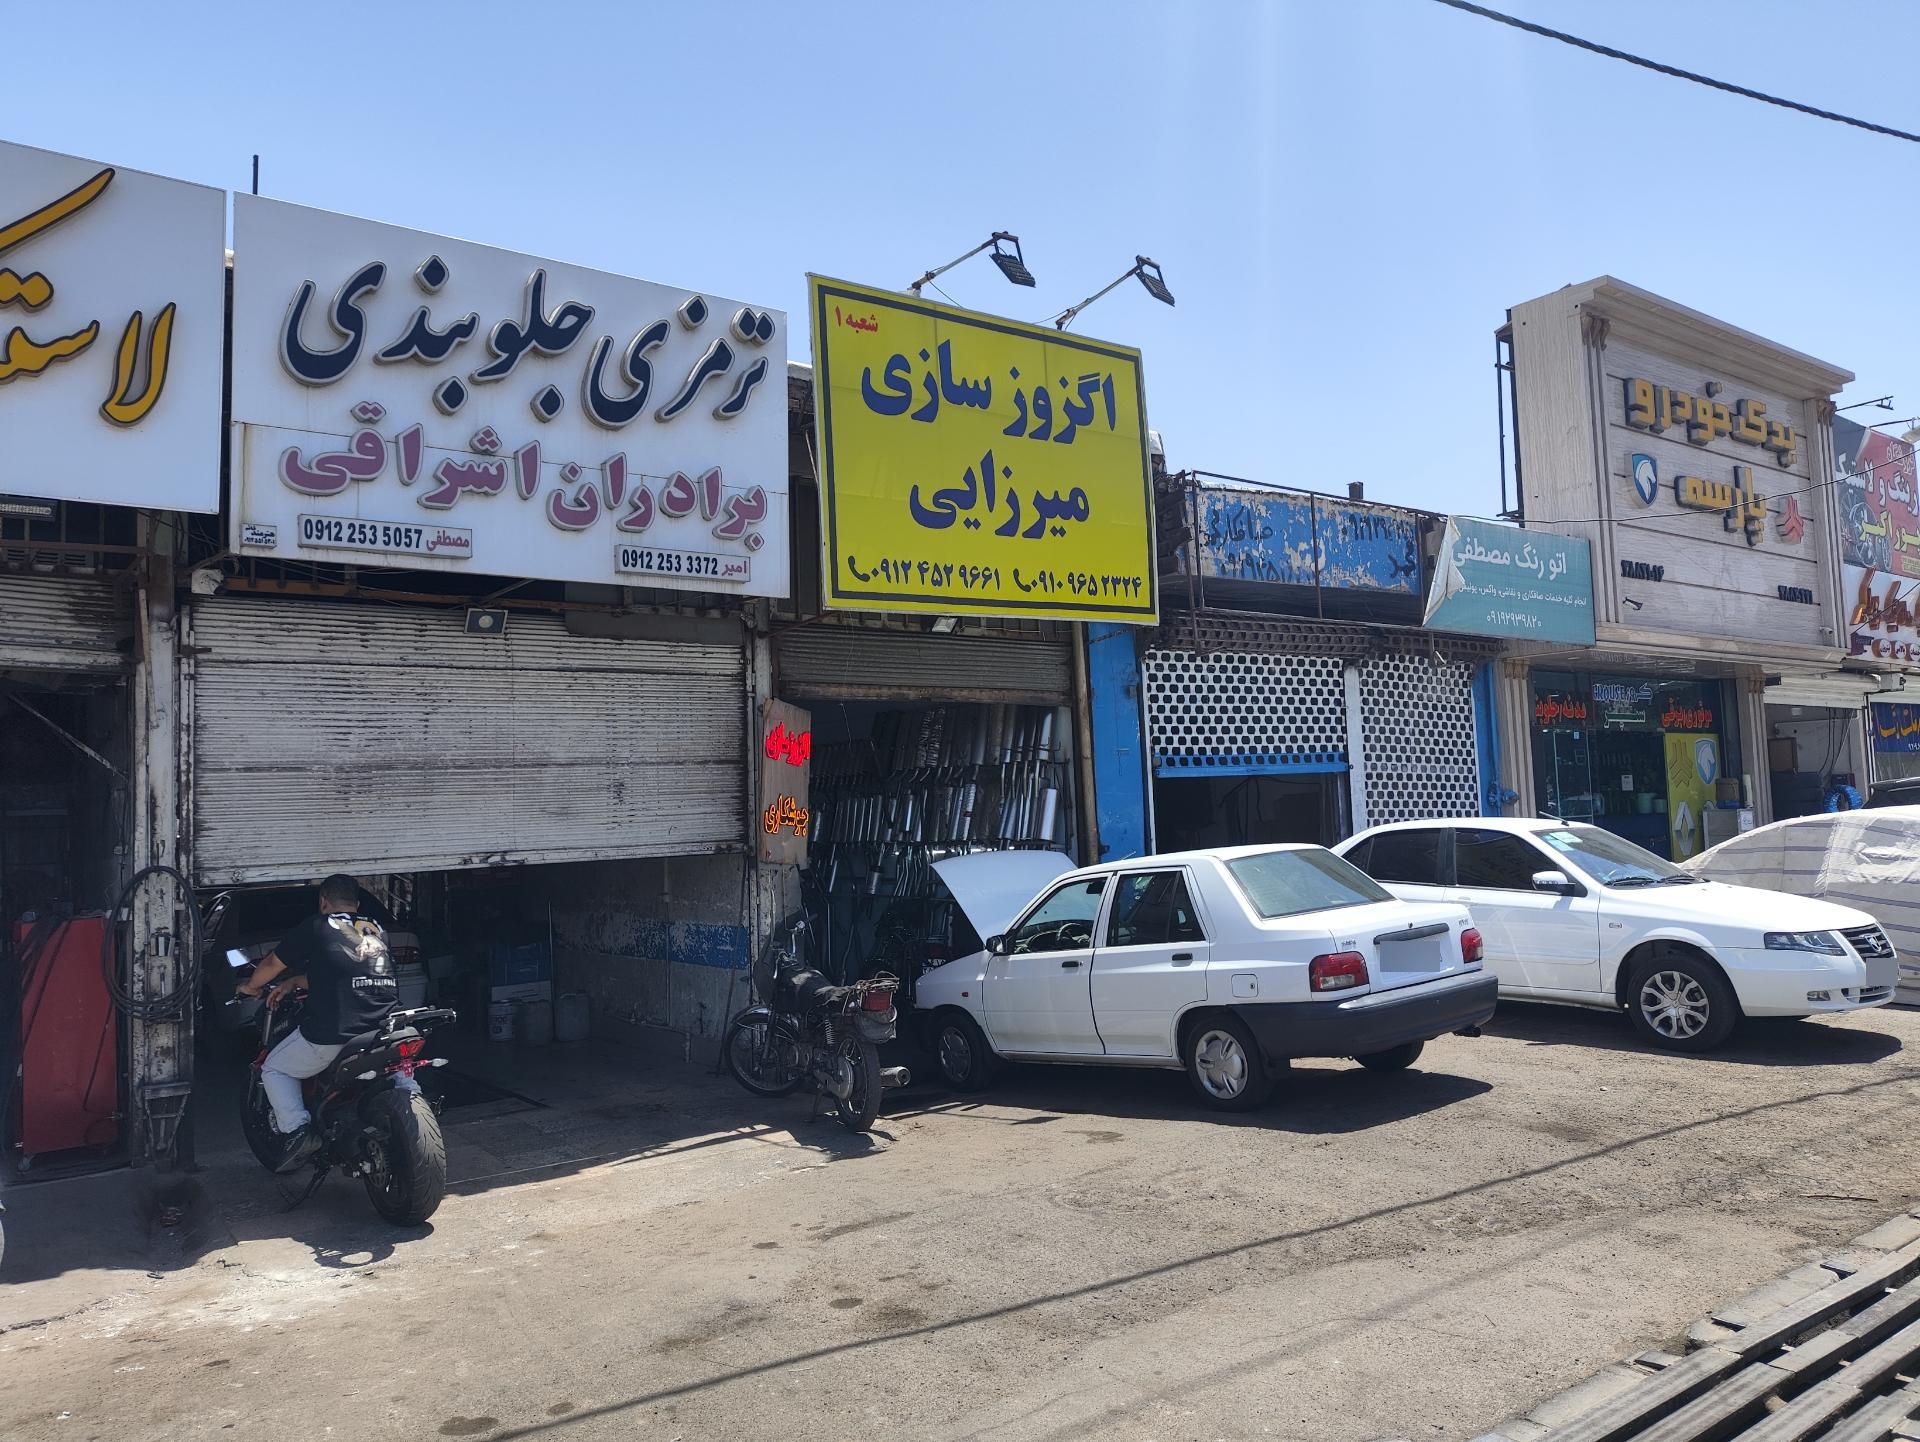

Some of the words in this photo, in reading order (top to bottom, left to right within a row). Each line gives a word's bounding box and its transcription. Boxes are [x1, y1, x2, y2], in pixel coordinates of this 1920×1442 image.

[835, 305, 842, 328] ۱
[846, 314, 878, 334] شعبه
[280, 254, 596, 423] جلوبندی
[581, 294, 775, 430] ترمزی
[861, 338, 992, 423] سازی
[1003, 366, 1116, 444] اگزوز
[1623, 377, 1733, 446] خودرو
[279, 400, 542, 511] اشراقی
[547, 451, 768, 553] برادران
[909, 449, 1090, 539] میرزایی
[304, 518, 343, 541] 0912
[347, 522, 378, 545] 253
[382, 526, 422, 549] 5057
[426, 528, 470, 551] مصطفی
[622, 549, 653, 570] 0912
[657, 552, 682, 572] 253
[686, 555, 718, 575] 3372
[1451, 536, 1511, 567] مصطفی
[1515, 542, 1544, 579] رنگ
[1549, 551, 1567, 581] اتو
[721, 561, 747, 576] امیر
[871, 558, 912, 584] ۰۹۱۲
[917, 560, 953, 588] ۴۵۲
[958, 564, 1000, 591] ۹۶۶۱
[1031, 570, 1063, 594] ۰۹۱۰
[1067, 571, 1098, 596] ۹۶۵
[765, 794, 809, 837] جوشکاری
